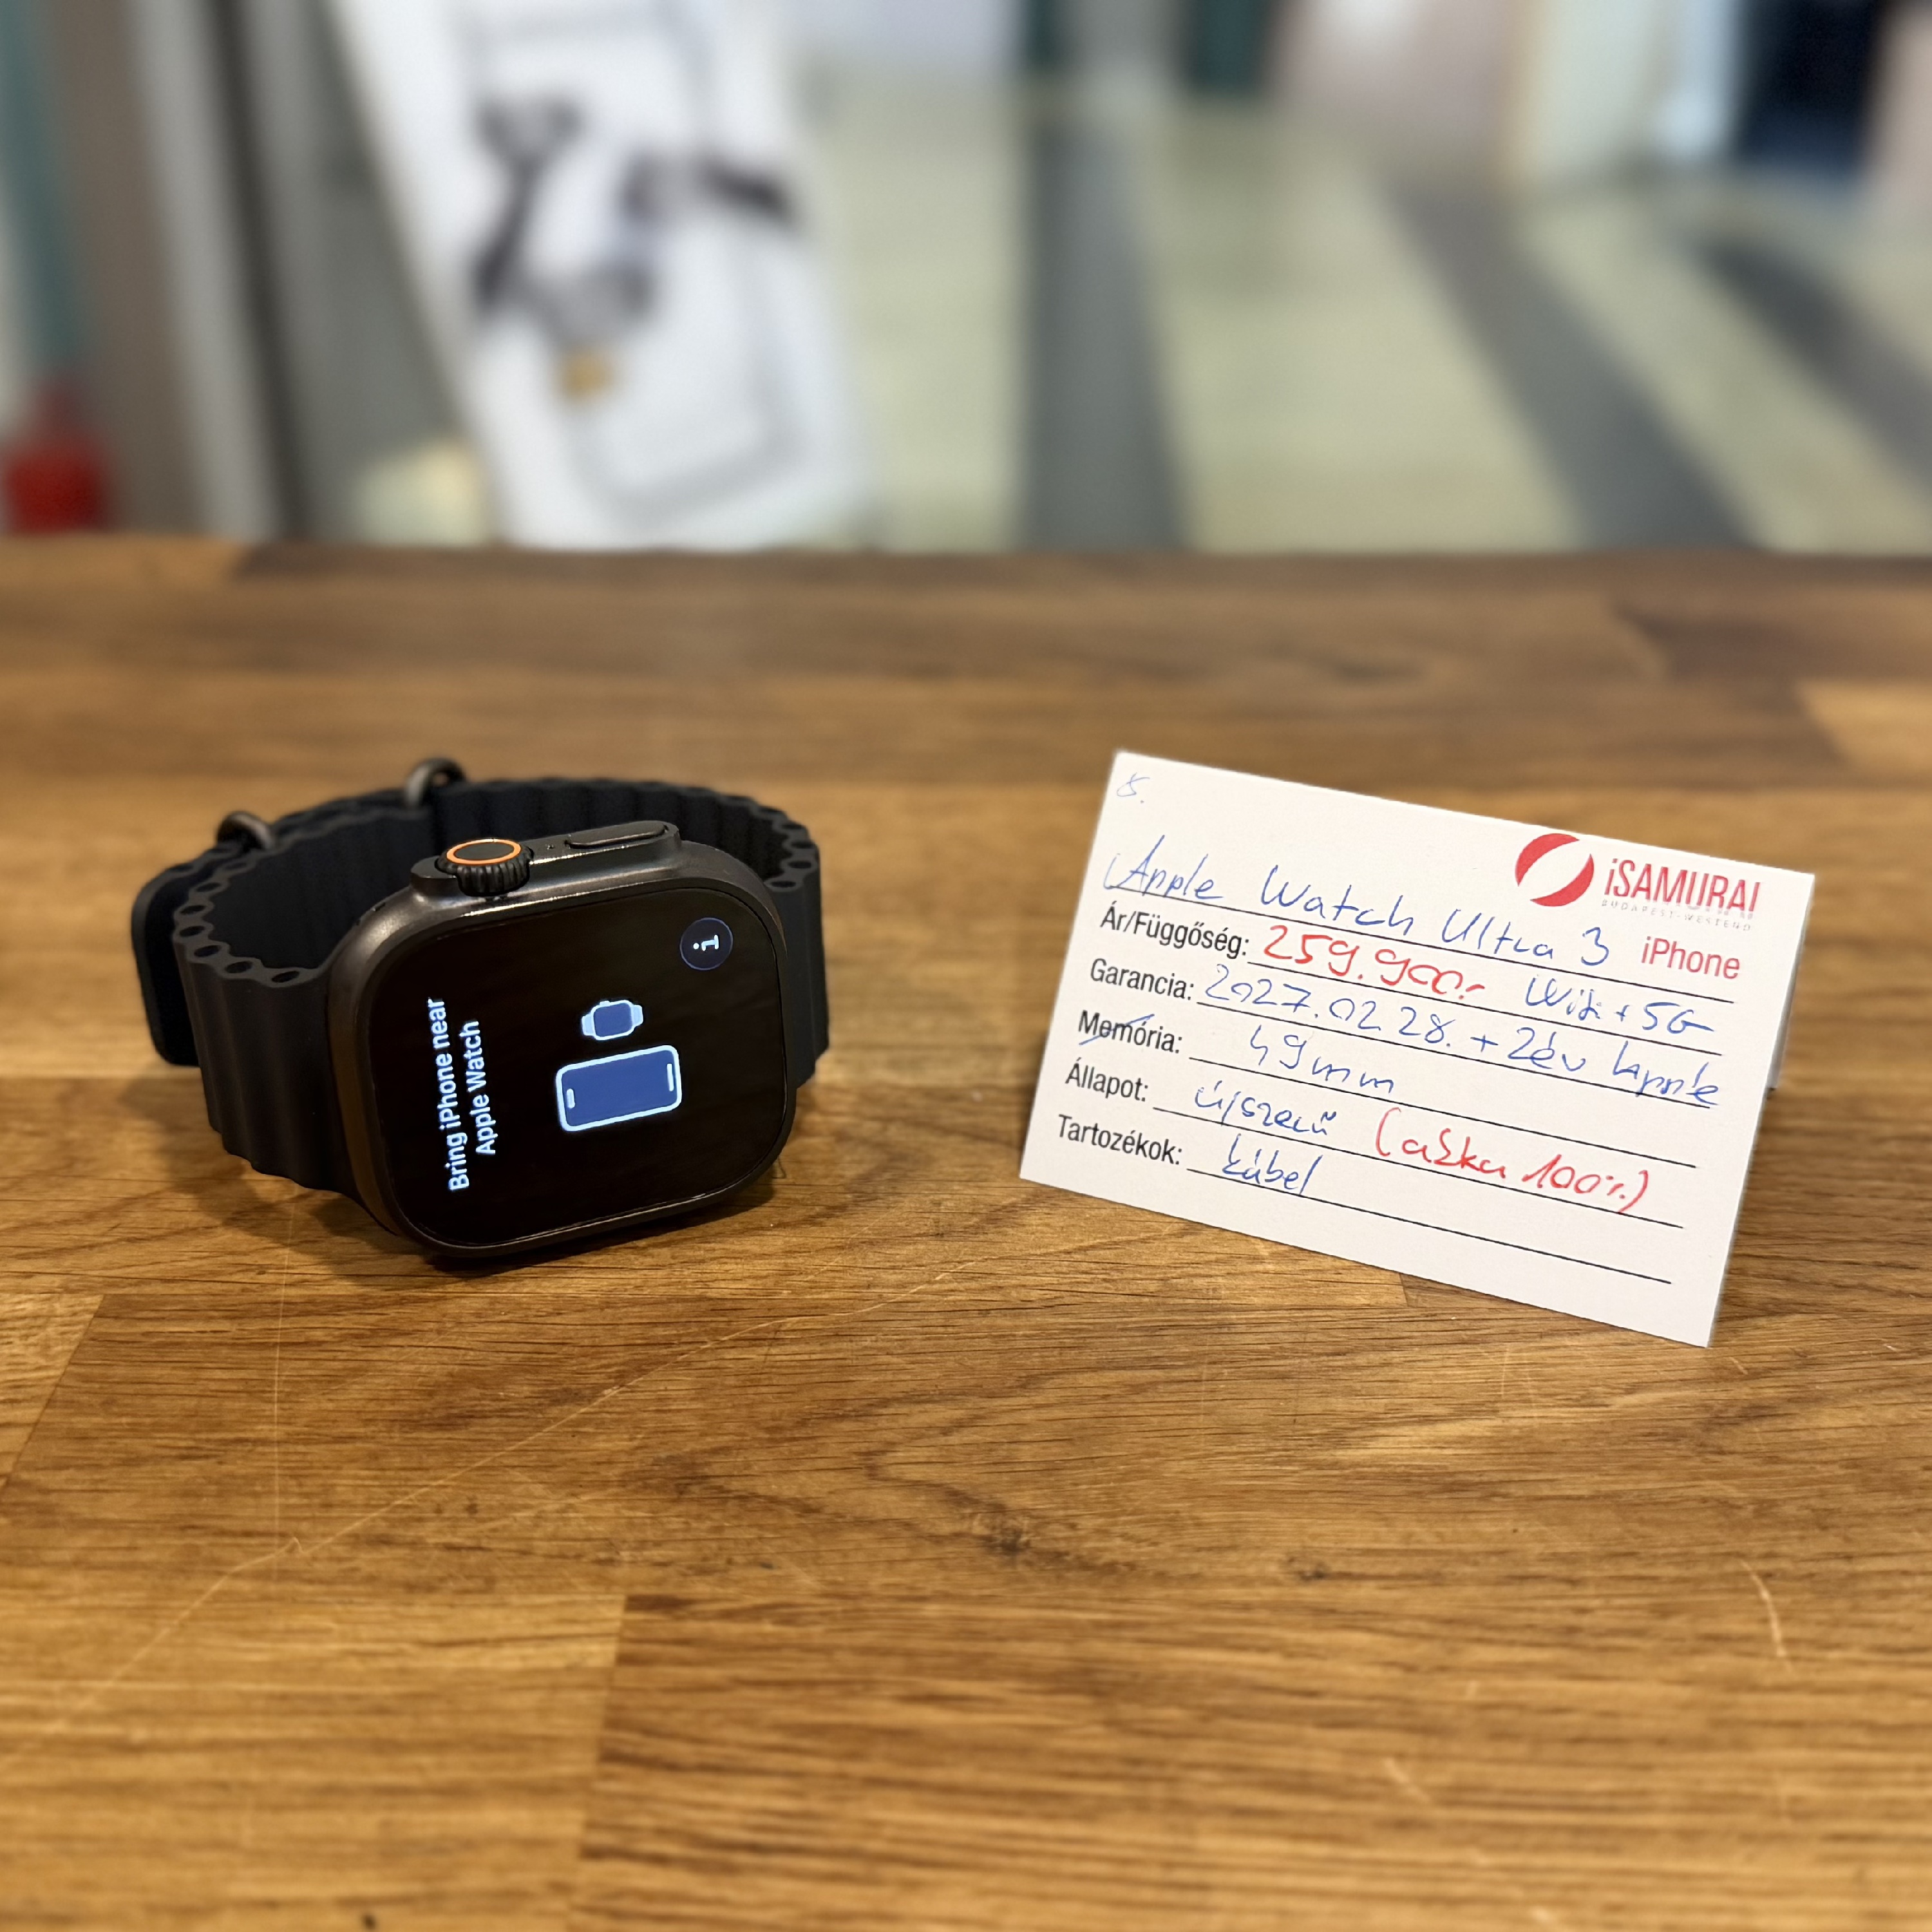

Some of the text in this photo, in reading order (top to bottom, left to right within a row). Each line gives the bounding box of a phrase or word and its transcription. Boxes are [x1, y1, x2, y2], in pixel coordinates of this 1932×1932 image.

[1103, 835, 1609, 966] Apple Watch Ultra 3
[1604, 858, 1761, 912] iSAMURAI
[1100, 902, 1249, 959] Ár/Függőség:
[1090, 958, 1194, 1001] Garancia:
[1641, 936, 1740, 980] iPhone
[1078, 1010, 1182, 1054] Memória:
[427, 997, 469, 1191] Bring iPhone near
[459, 1019, 498, 1155] Apple Watch
[1065, 1057, 1149, 1102] Állapot:
[1057, 1114, 1183, 1166] Tartozékok:
